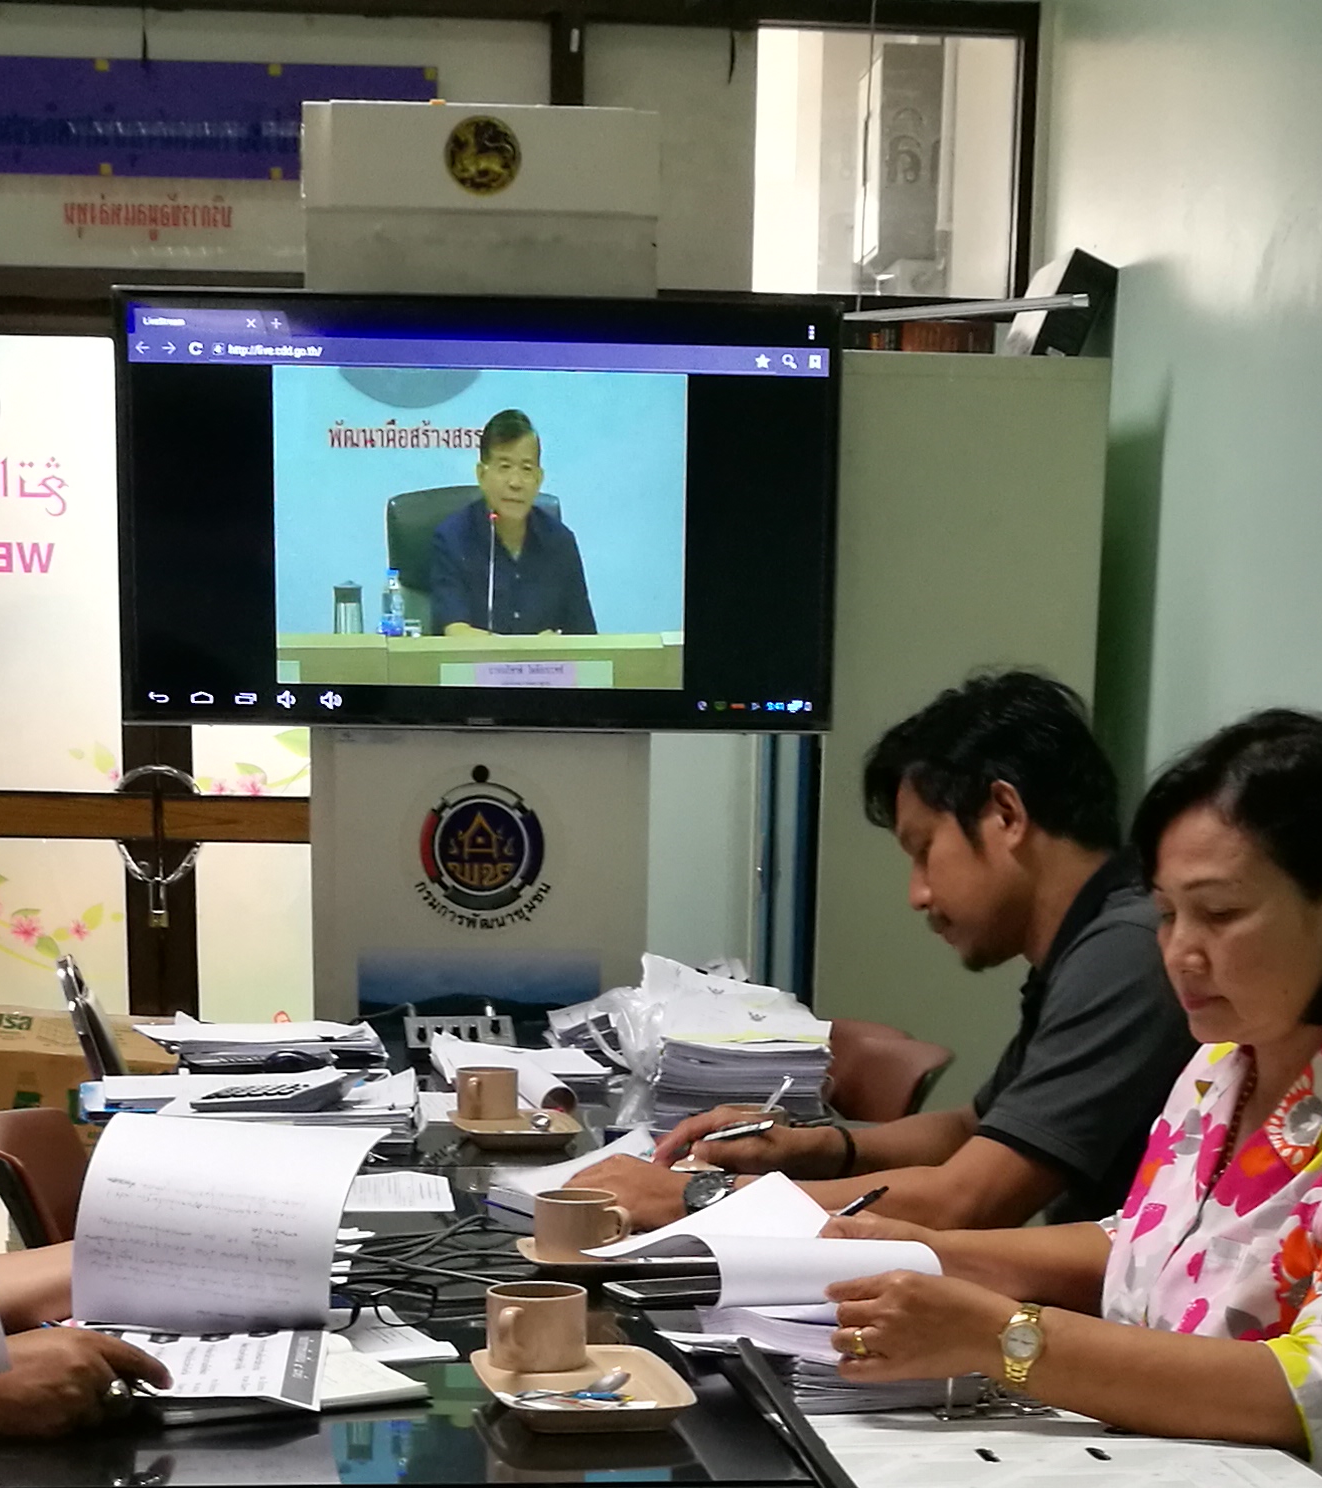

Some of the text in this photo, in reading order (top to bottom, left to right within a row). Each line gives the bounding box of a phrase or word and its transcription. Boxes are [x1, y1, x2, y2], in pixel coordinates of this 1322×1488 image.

[414, 881, 552, 930] กรมการพัฒนาชุมชน
